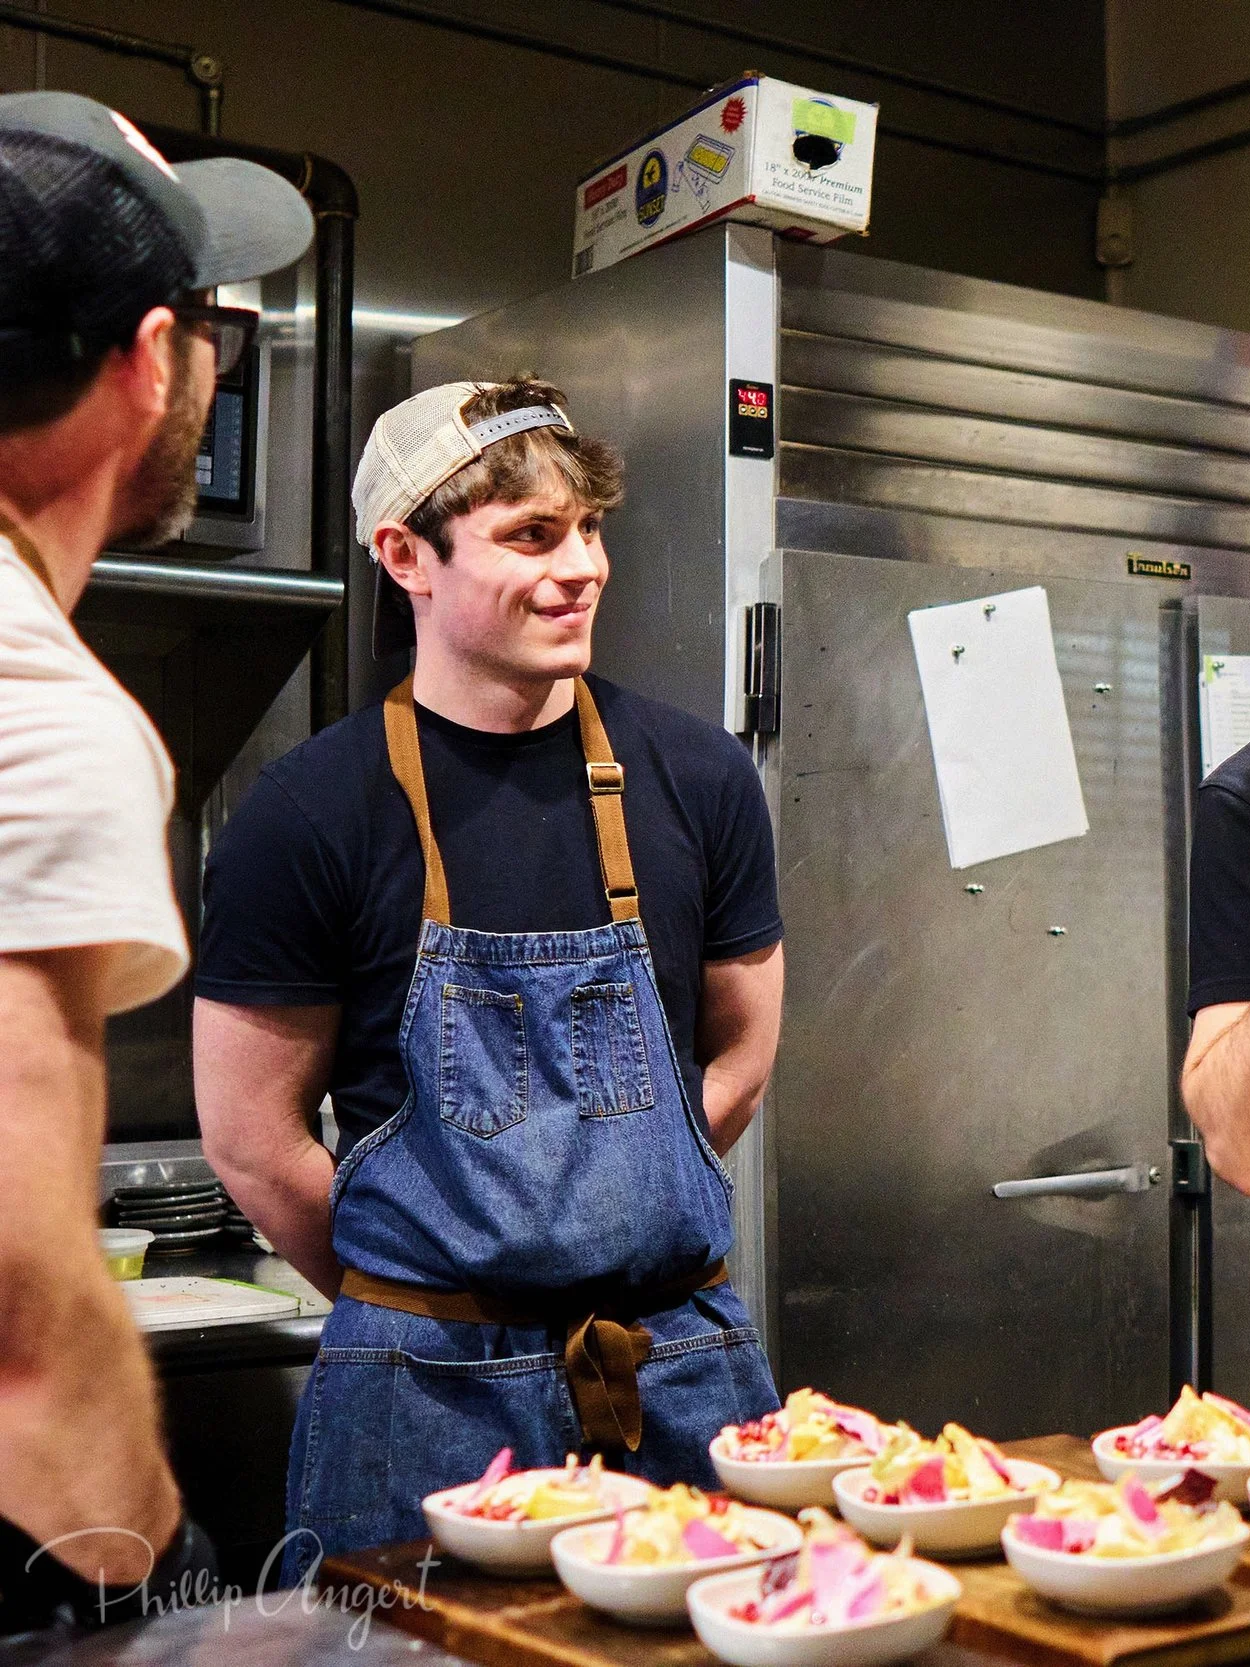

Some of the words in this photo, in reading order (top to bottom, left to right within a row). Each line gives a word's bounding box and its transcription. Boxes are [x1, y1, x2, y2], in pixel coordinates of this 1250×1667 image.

[772, 177, 795, 192] Food
[798, 184, 831, 201] Service
[833, 192, 854, 206] Film
[820, 175, 863, 194] Premium
